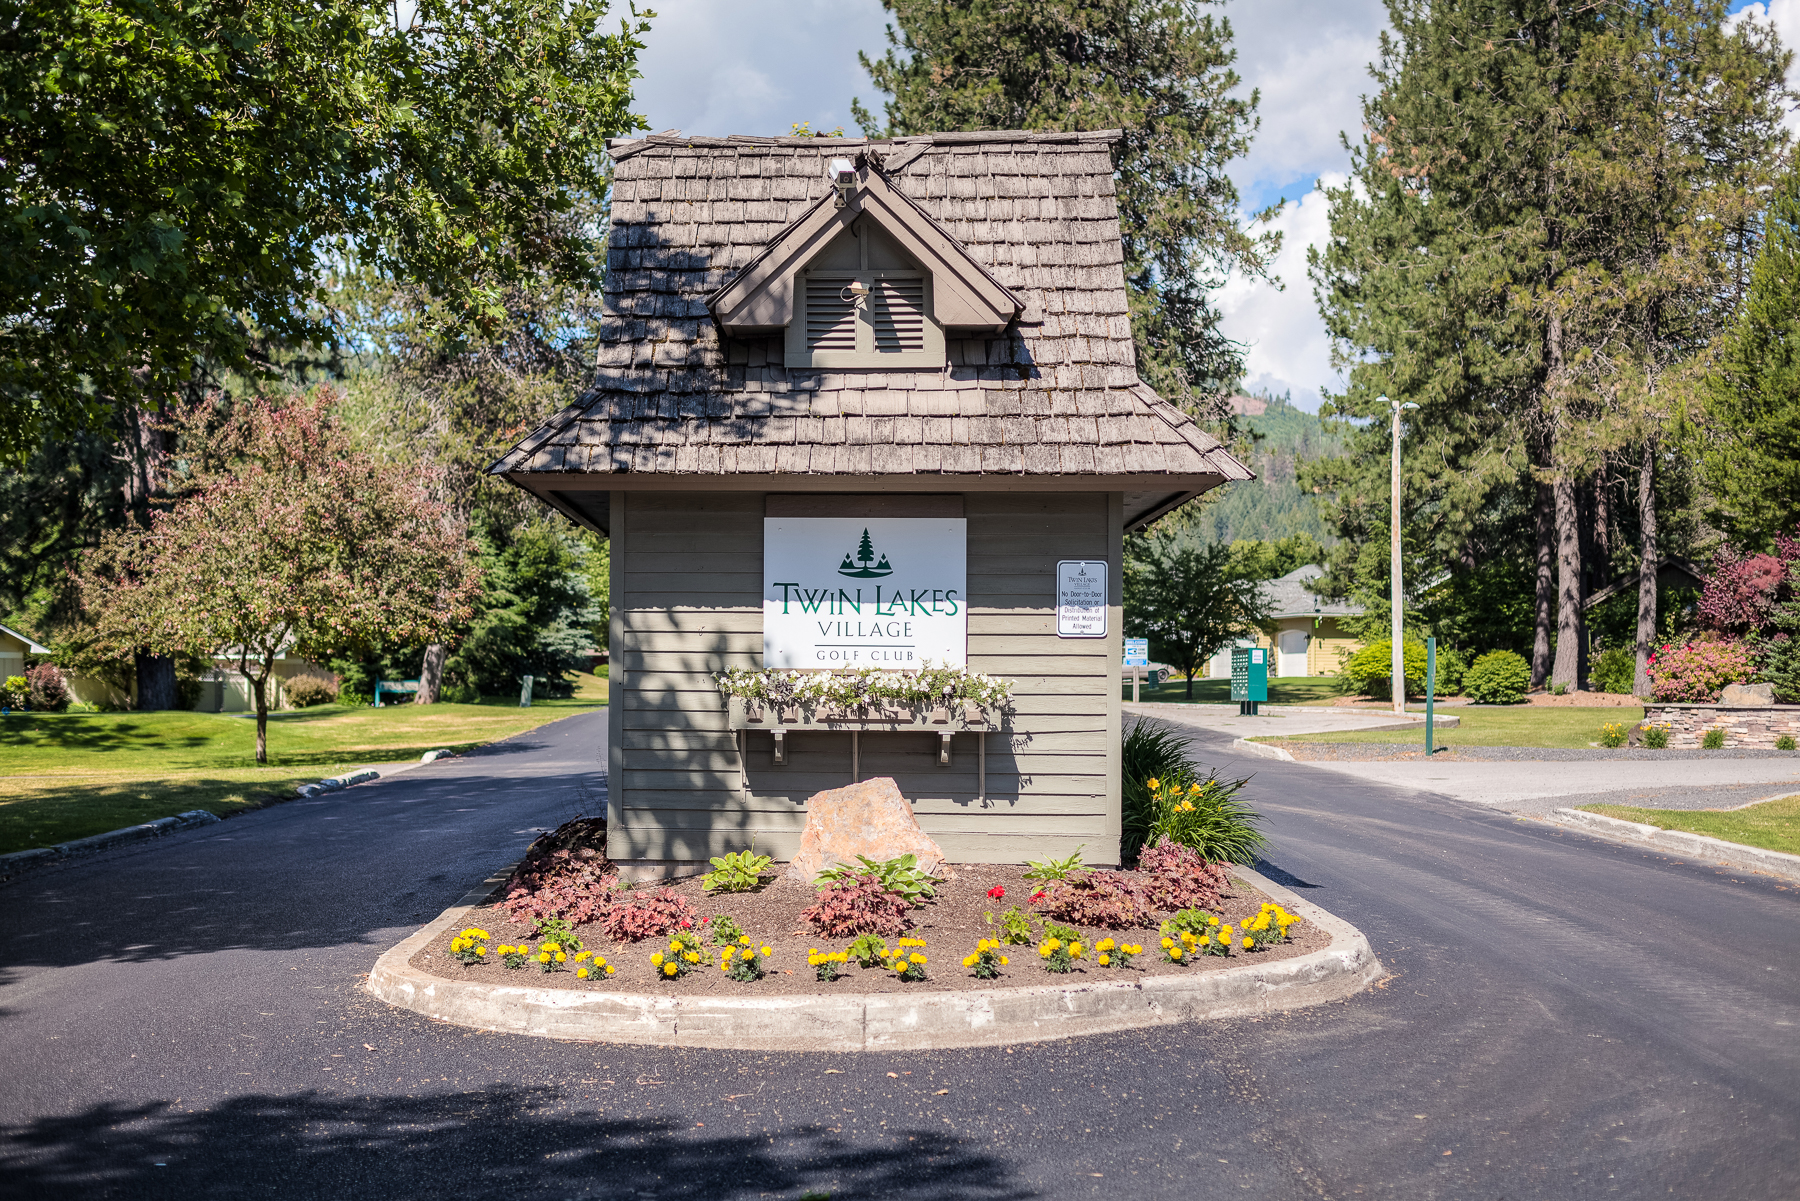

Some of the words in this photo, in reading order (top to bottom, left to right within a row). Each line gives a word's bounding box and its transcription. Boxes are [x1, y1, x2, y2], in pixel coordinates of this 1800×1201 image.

[773, 582, 862, 615] TWIN
[875, 585, 958, 616] LAKES
[818, 621, 913, 638] VILLAGE
[816, 650, 860, 661] GOLF
[871, 650, 914, 661] CLUB
